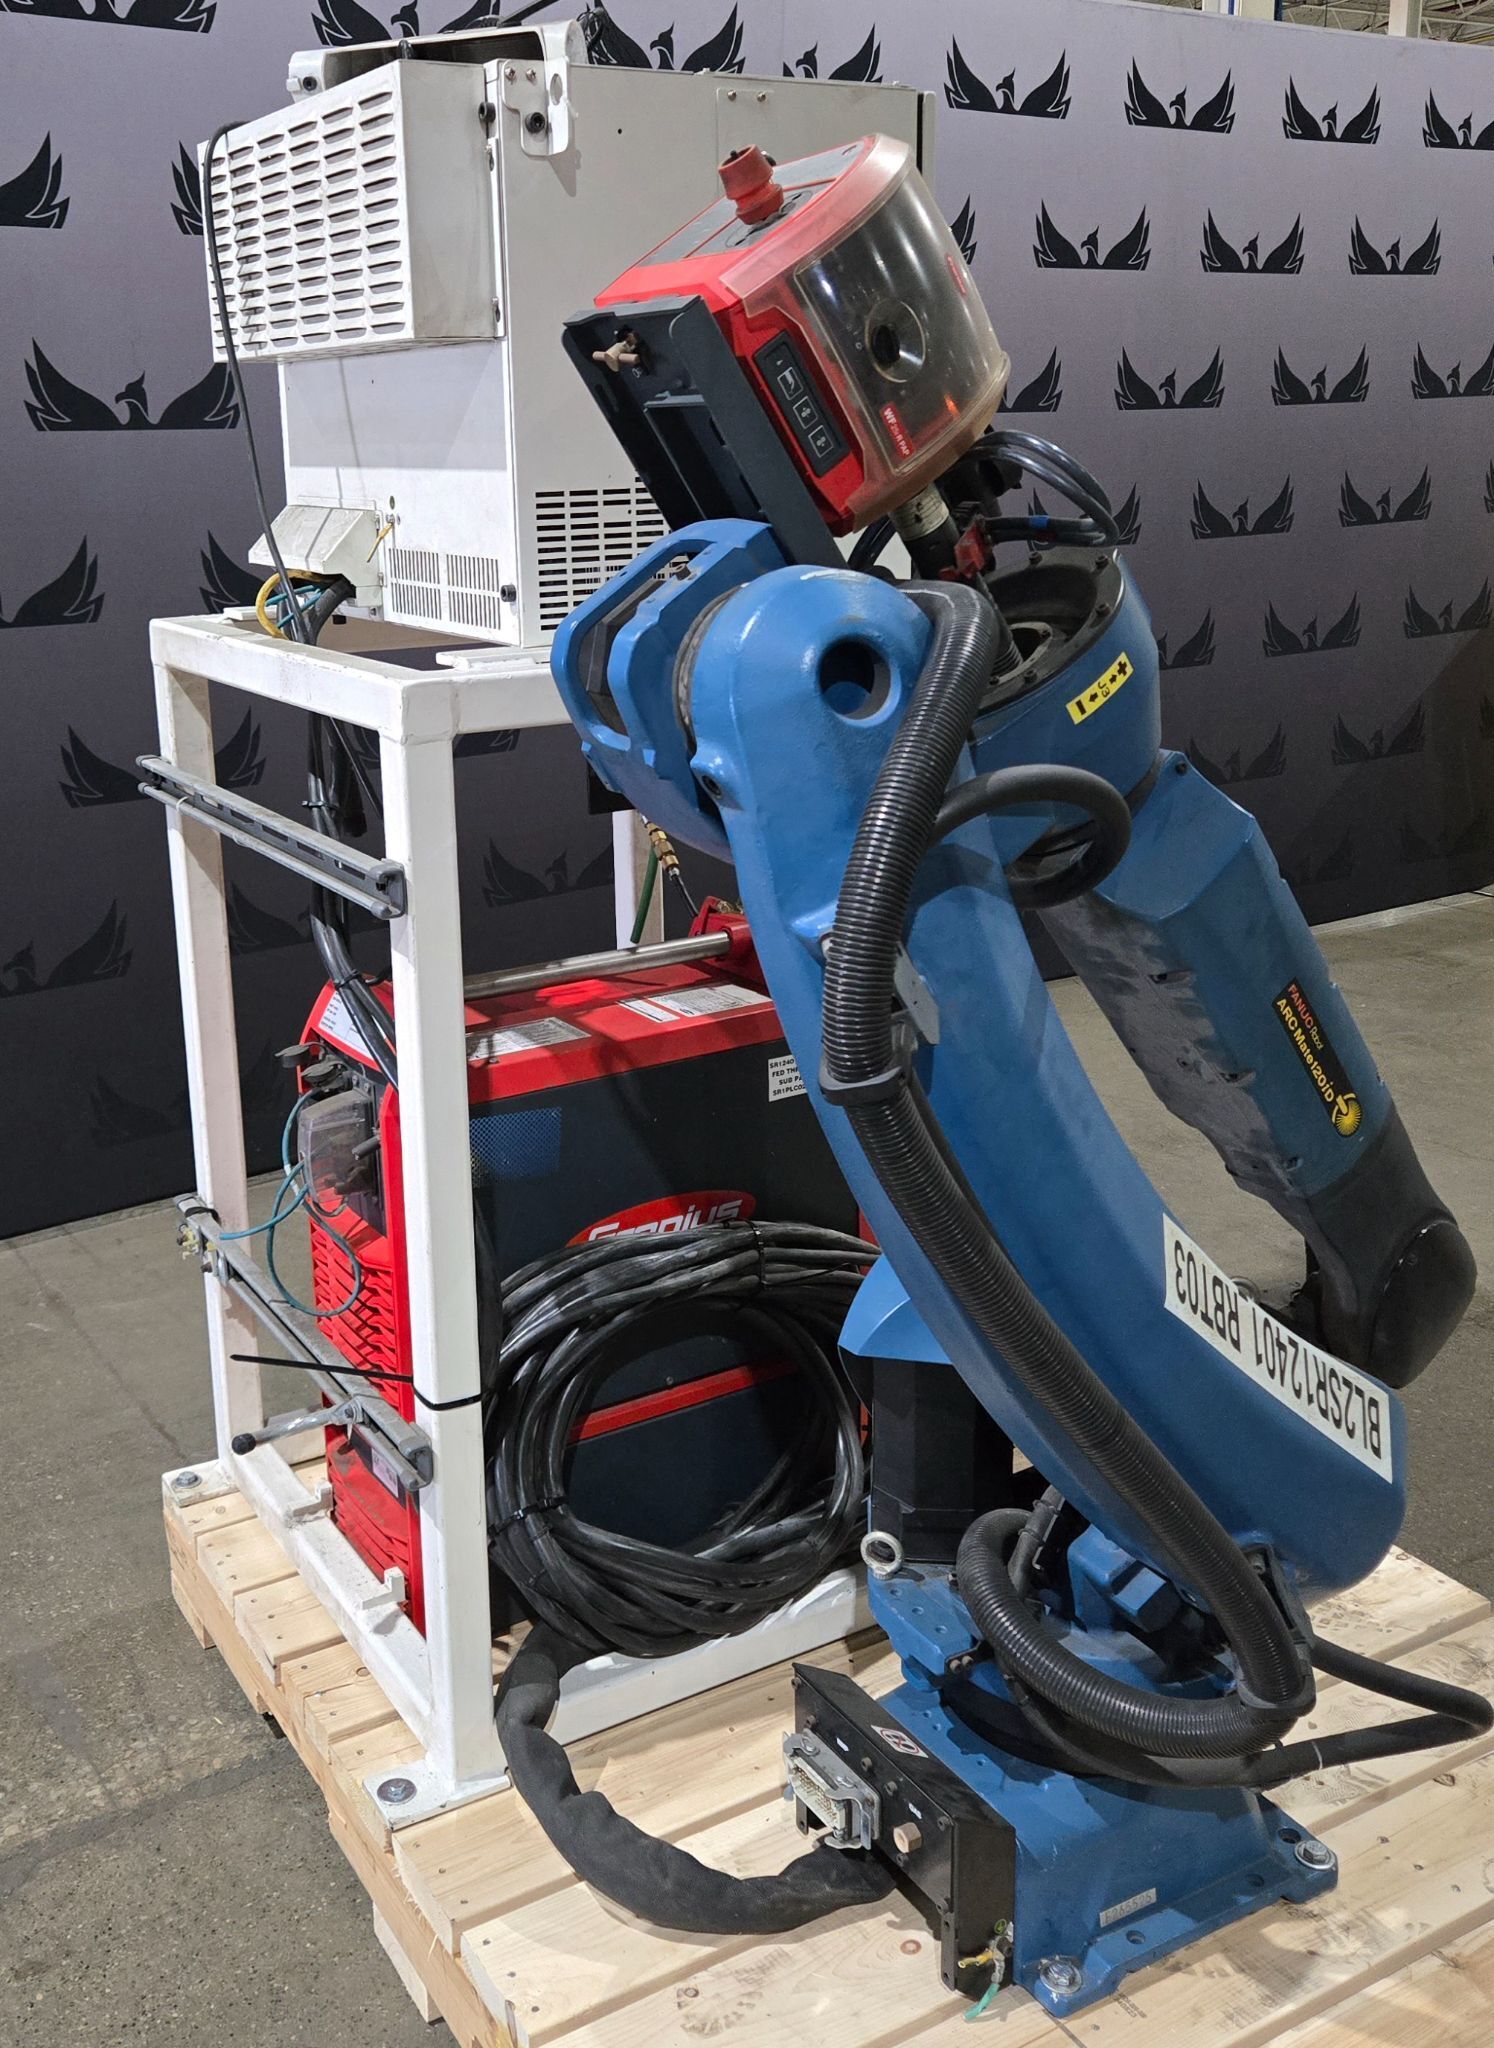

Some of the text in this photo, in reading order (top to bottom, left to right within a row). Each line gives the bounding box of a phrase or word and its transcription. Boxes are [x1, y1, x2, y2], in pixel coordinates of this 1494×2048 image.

[1276, 998, 1298, 1031] ARC
[1287, 983, 1314, 1029] FANUC
[772, 1069, 785, 1078] FED
